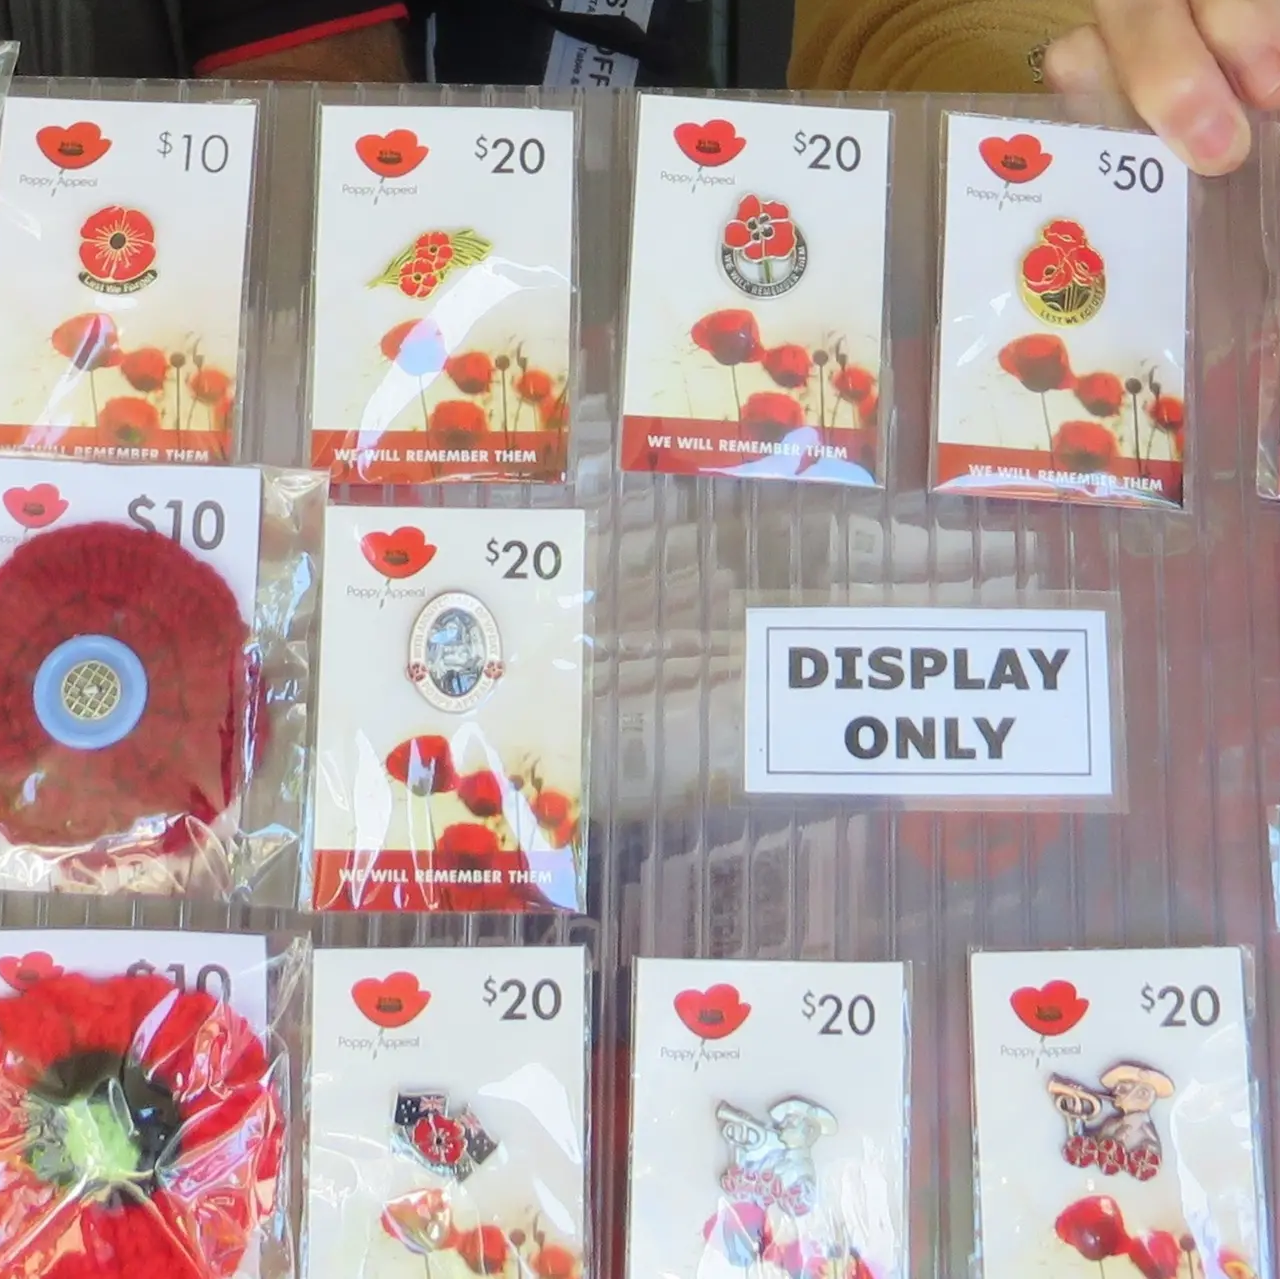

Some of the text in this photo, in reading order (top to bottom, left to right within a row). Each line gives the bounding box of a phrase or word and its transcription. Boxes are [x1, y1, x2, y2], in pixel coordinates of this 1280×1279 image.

[158, 130, 228, 172] $10
[475, 136, 545, 174] $20
[793, 131, 861, 171] $20
[19, 174, 98, 188] Poppy Appeal
[660, 171, 735, 185] Poppy Appeal
[1099, 150, 1164, 194] $50
[342, 185, 418, 195] Poppy Appeal
[966, 188, 1042, 203] Poppy Appeal
[164, 449, 208, 462] THEM
[335, 449, 536, 463] WE WILL REMEMBER THEM
[648, 436, 847, 459] WE WILL REMEMBER THEM
[968, 464, 1162, 490] WE WILL REMEMBER THEM
[126, 496, 225, 550] $10
[486, 539, 562, 579] $20
[347, 586, 426, 598] Poppy Appeal
[788, 646, 1071, 691] DISPLAY
[844, 718, 1016, 760] ONLY
[339, 869, 552, 884] WE WILL REMEMBER THEM
[482, 977, 561, 1020] $20
[1141, 983, 1220, 1026] $20
[802, 990, 875, 1035] $20
[338, 1036, 419, 1048] Poppy Appeal
[661, 1047, 740, 1059] Poppy Appeal
[1001, 1045, 1081, 1056] Poppy Appeal
